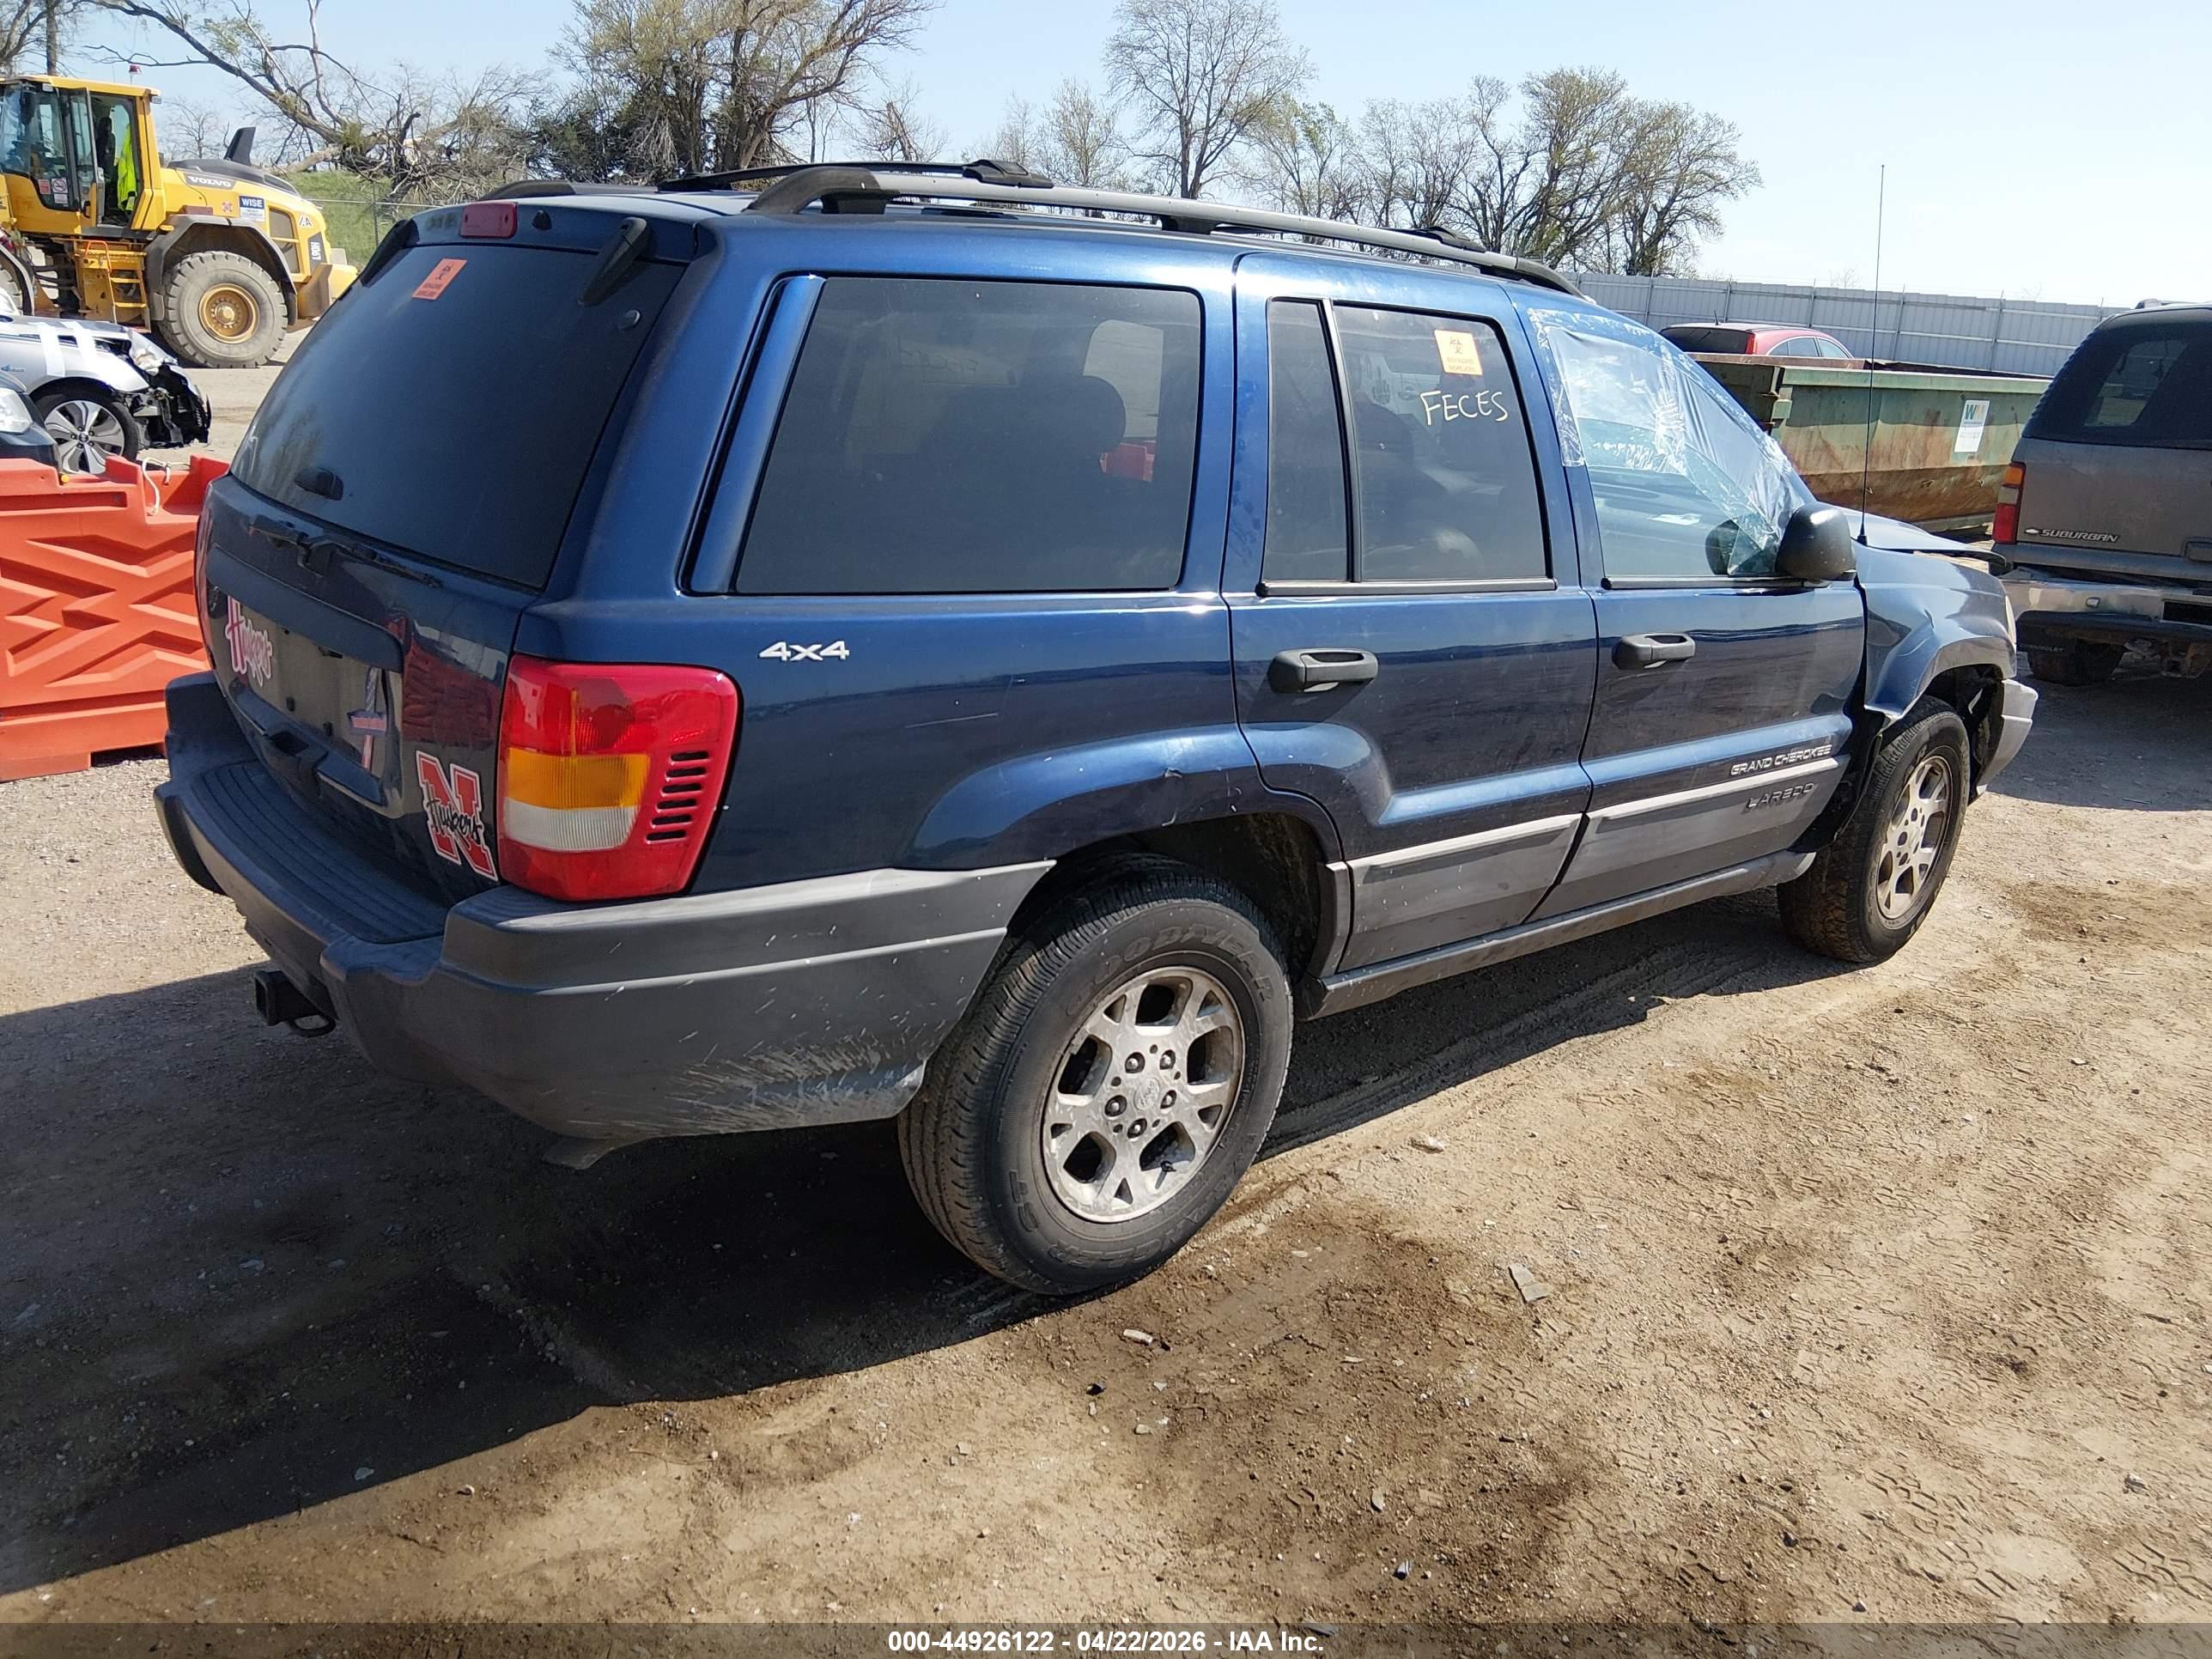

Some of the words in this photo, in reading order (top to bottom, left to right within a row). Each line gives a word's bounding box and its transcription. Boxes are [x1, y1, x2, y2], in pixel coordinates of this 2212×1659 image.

[189, 176, 232, 187] VOLVO
[242, 198, 263, 208] WISE
[311, 242, 321, 260] L90H
[1419, 390, 1509, 426] FECES
[2040, 529, 2119, 542] SUBURBAN
[1730, 757, 1773, 775] GRAND
[1774, 744, 1832, 766] CHEROKEE
[1746, 782, 1814, 808] LAREDO
[416, 750, 499, 882] N
[426, 780, 483, 849] Huskers
